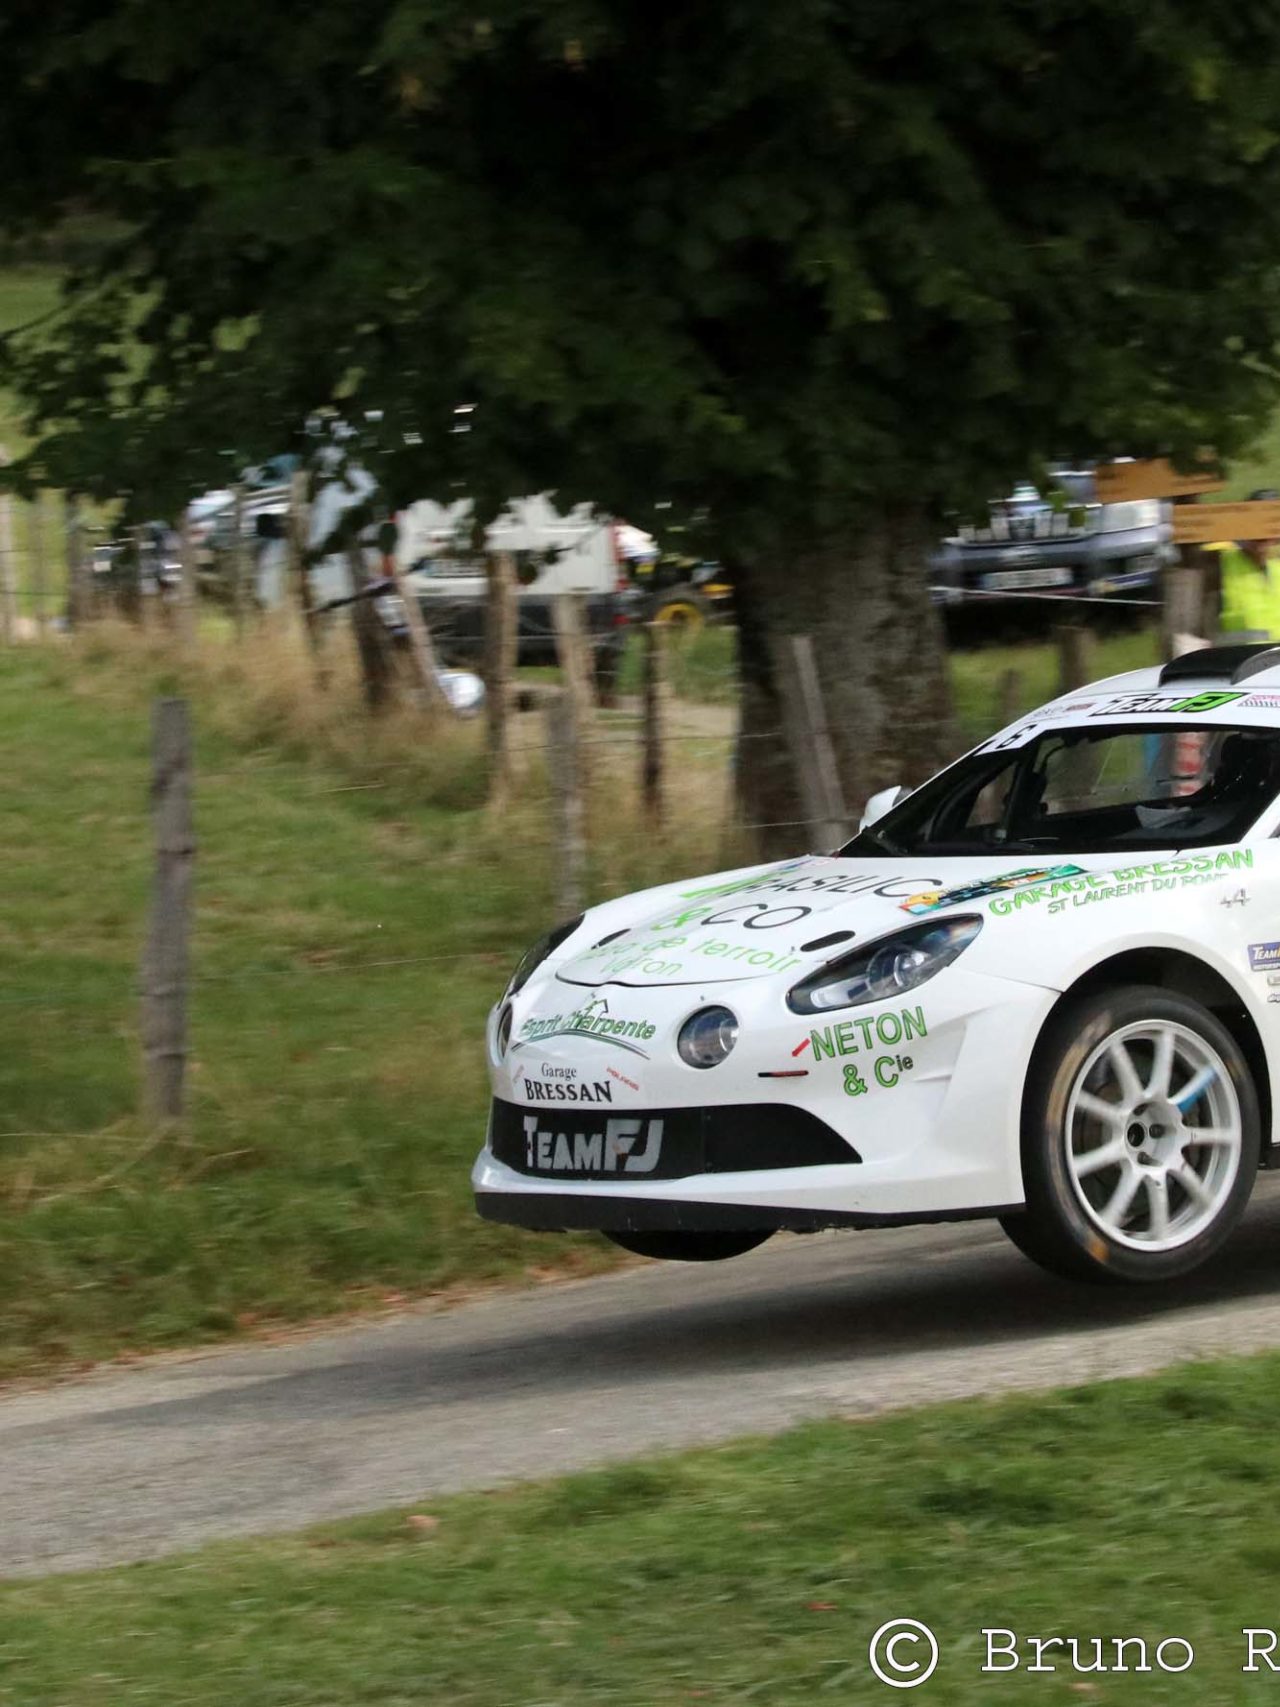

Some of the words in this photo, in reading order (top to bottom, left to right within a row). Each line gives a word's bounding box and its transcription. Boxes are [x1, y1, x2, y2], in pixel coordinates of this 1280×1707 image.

[988, 871, 1108, 916] GARAGE
[1113, 848, 1254, 880] BRESSAN
[1048, 897, 1072, 915] ST
[1072, 877, 1148, 907] LAURENT
[1152, 876, 1176, 891] DU
[689, 937, 804, 974] terroir
[520, 1014, 563, 1038] Esprit
[562, 1010, 657, 1040] Charpente
[810, 1006, 928, 1061] NETON
[523, 1078, 614, 1103] BRESSAN
[541, 1062, 578, 1081] Garage
[842, 1063, 869, 1097] &
[873, 1054, 915, 1089] Cie
